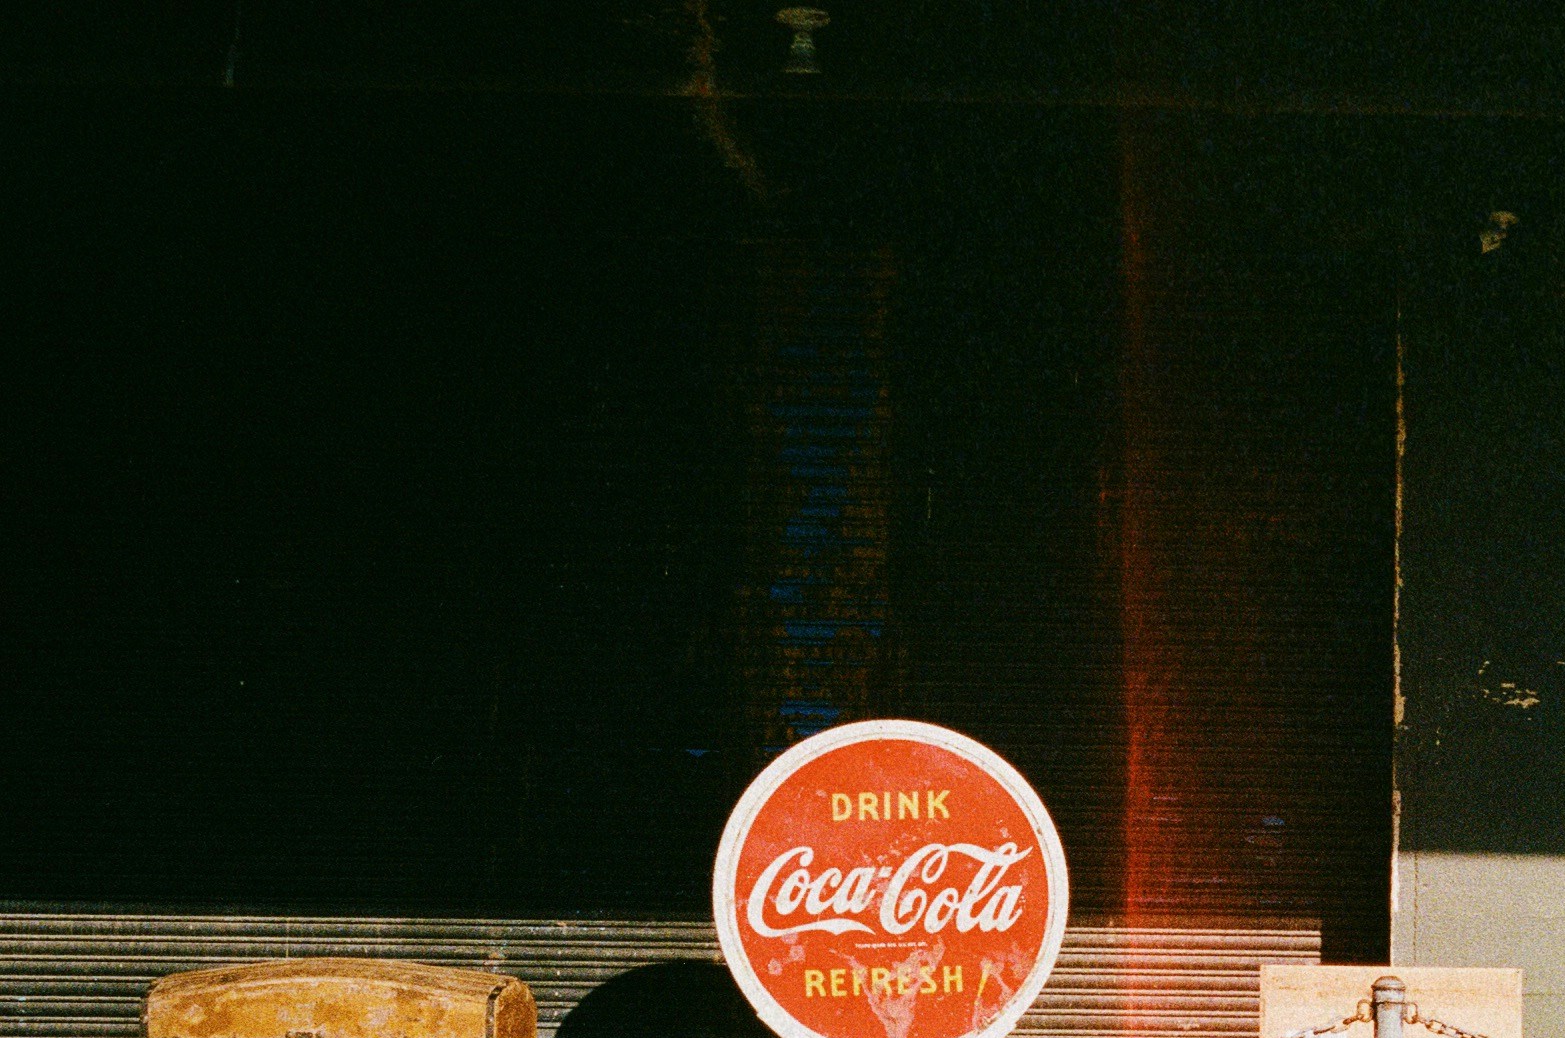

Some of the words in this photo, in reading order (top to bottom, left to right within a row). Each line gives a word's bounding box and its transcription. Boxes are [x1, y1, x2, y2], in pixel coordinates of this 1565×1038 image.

[832, 789, 951, 822] DRINK
[747, 841, 1034, 938] Coca-Cola
[804, 965, 964, 998] REFRESH
